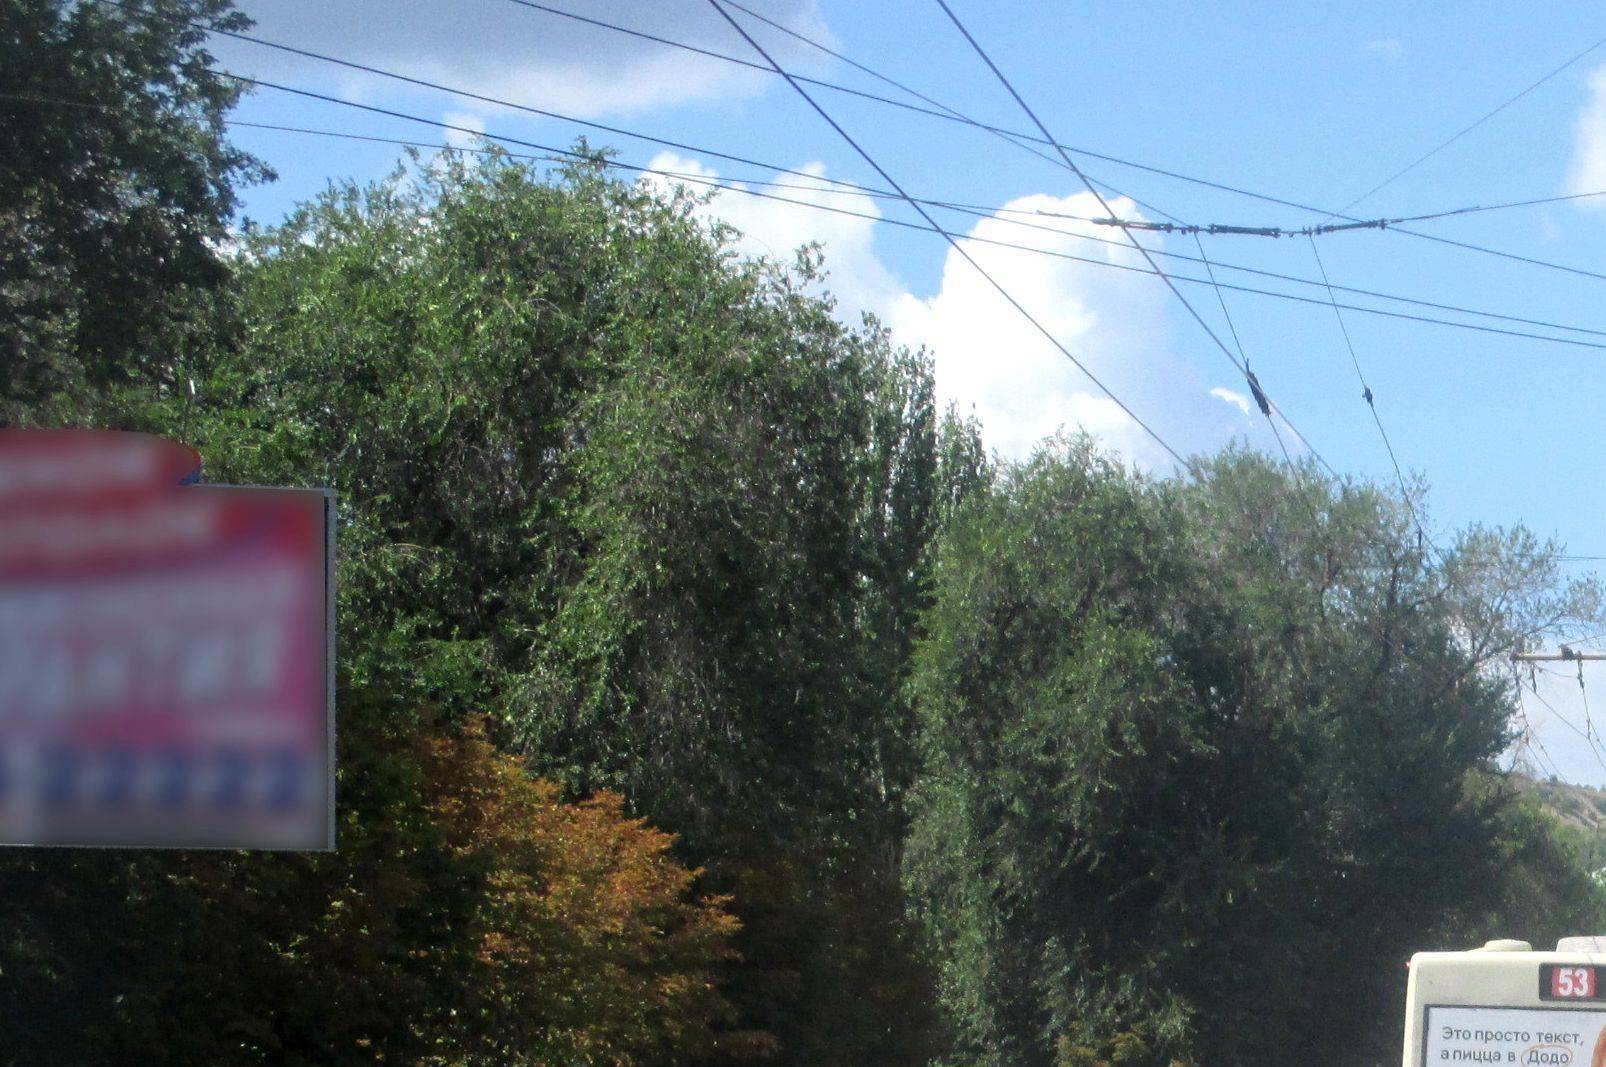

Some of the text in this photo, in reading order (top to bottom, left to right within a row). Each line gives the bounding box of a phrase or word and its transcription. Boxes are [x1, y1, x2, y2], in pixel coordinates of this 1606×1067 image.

[1559, 967, 1589, 997] 53
[1441, 1026, 1584, 1046] Это просто текст,
[1440, 1050, 1569, 1065] а пицца в Додо
